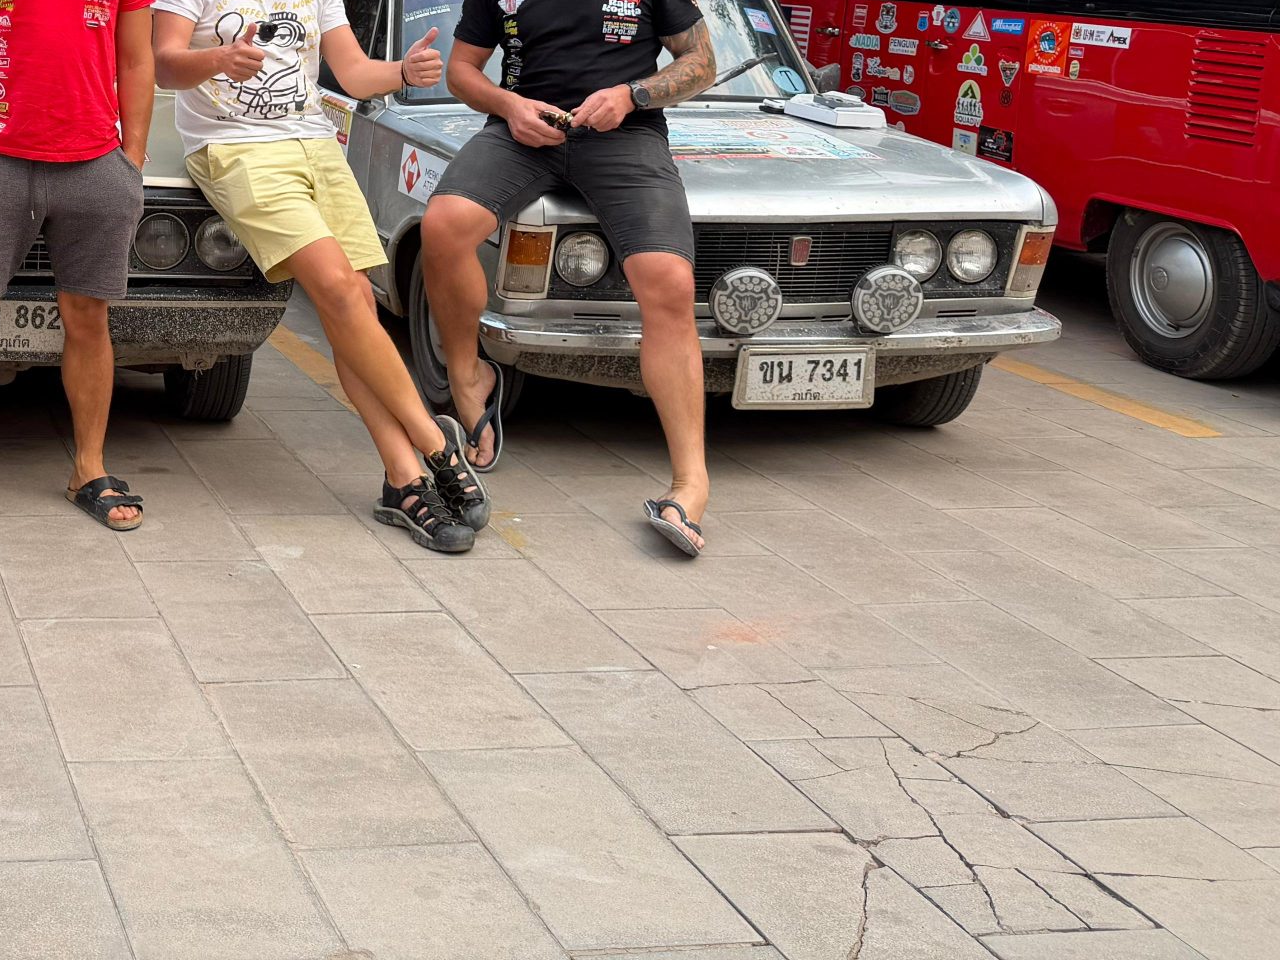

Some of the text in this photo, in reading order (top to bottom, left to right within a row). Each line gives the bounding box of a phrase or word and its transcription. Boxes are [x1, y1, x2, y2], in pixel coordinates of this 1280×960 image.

[854, 34, 879, 49] NADIA
[890, 38, 917, 49] PENGUIN
[778, 70, 799, 92] T
[758, 357, 863, 384] ขน 7341
[791, 388, 822, 400] ภเก็ต
